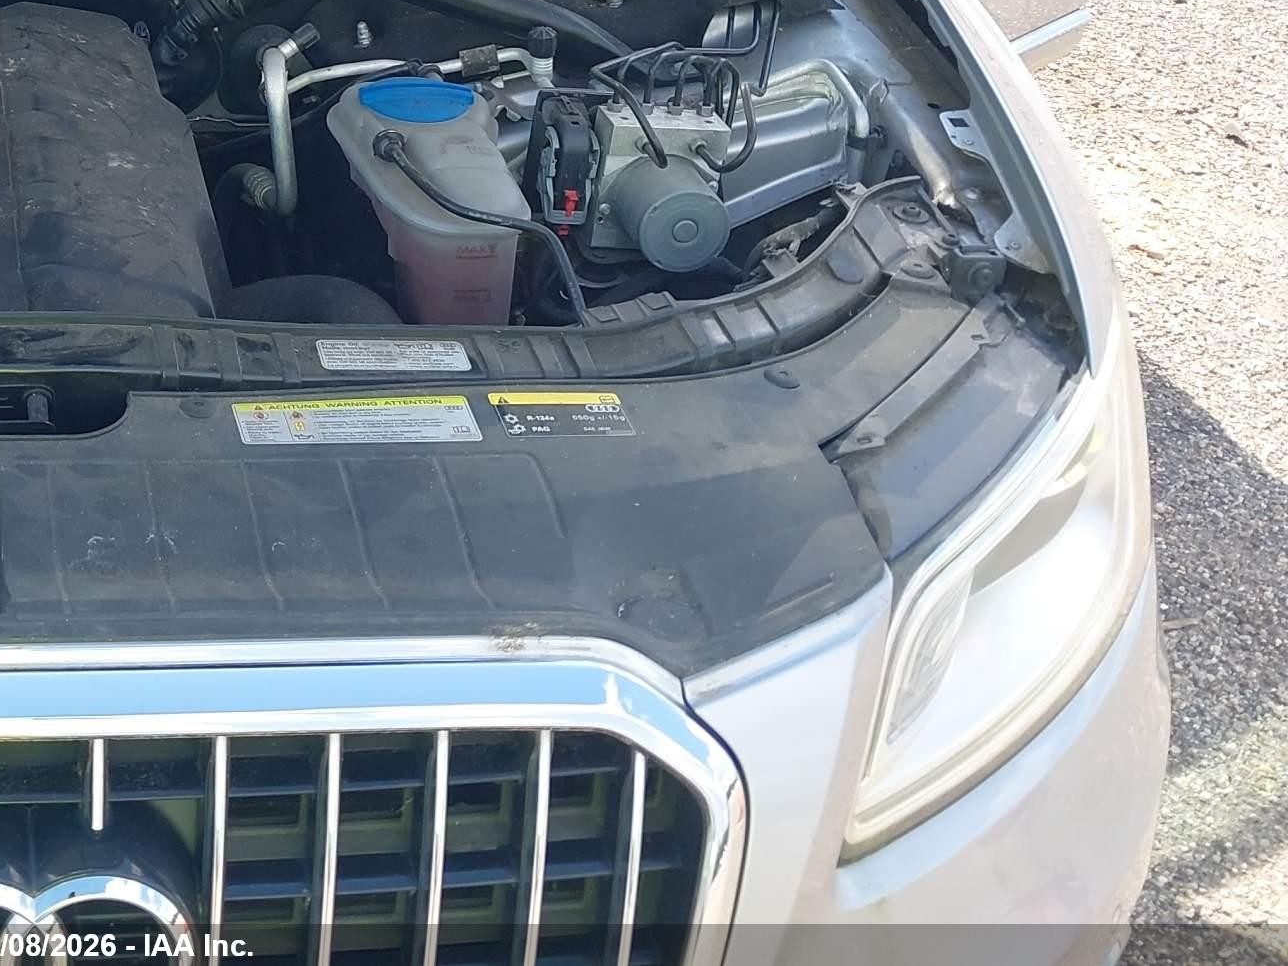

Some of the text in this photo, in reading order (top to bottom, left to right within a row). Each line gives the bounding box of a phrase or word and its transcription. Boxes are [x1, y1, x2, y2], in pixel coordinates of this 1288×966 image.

[268, 398, 443, 411] ACHTUNG WARNING ATTENTION
